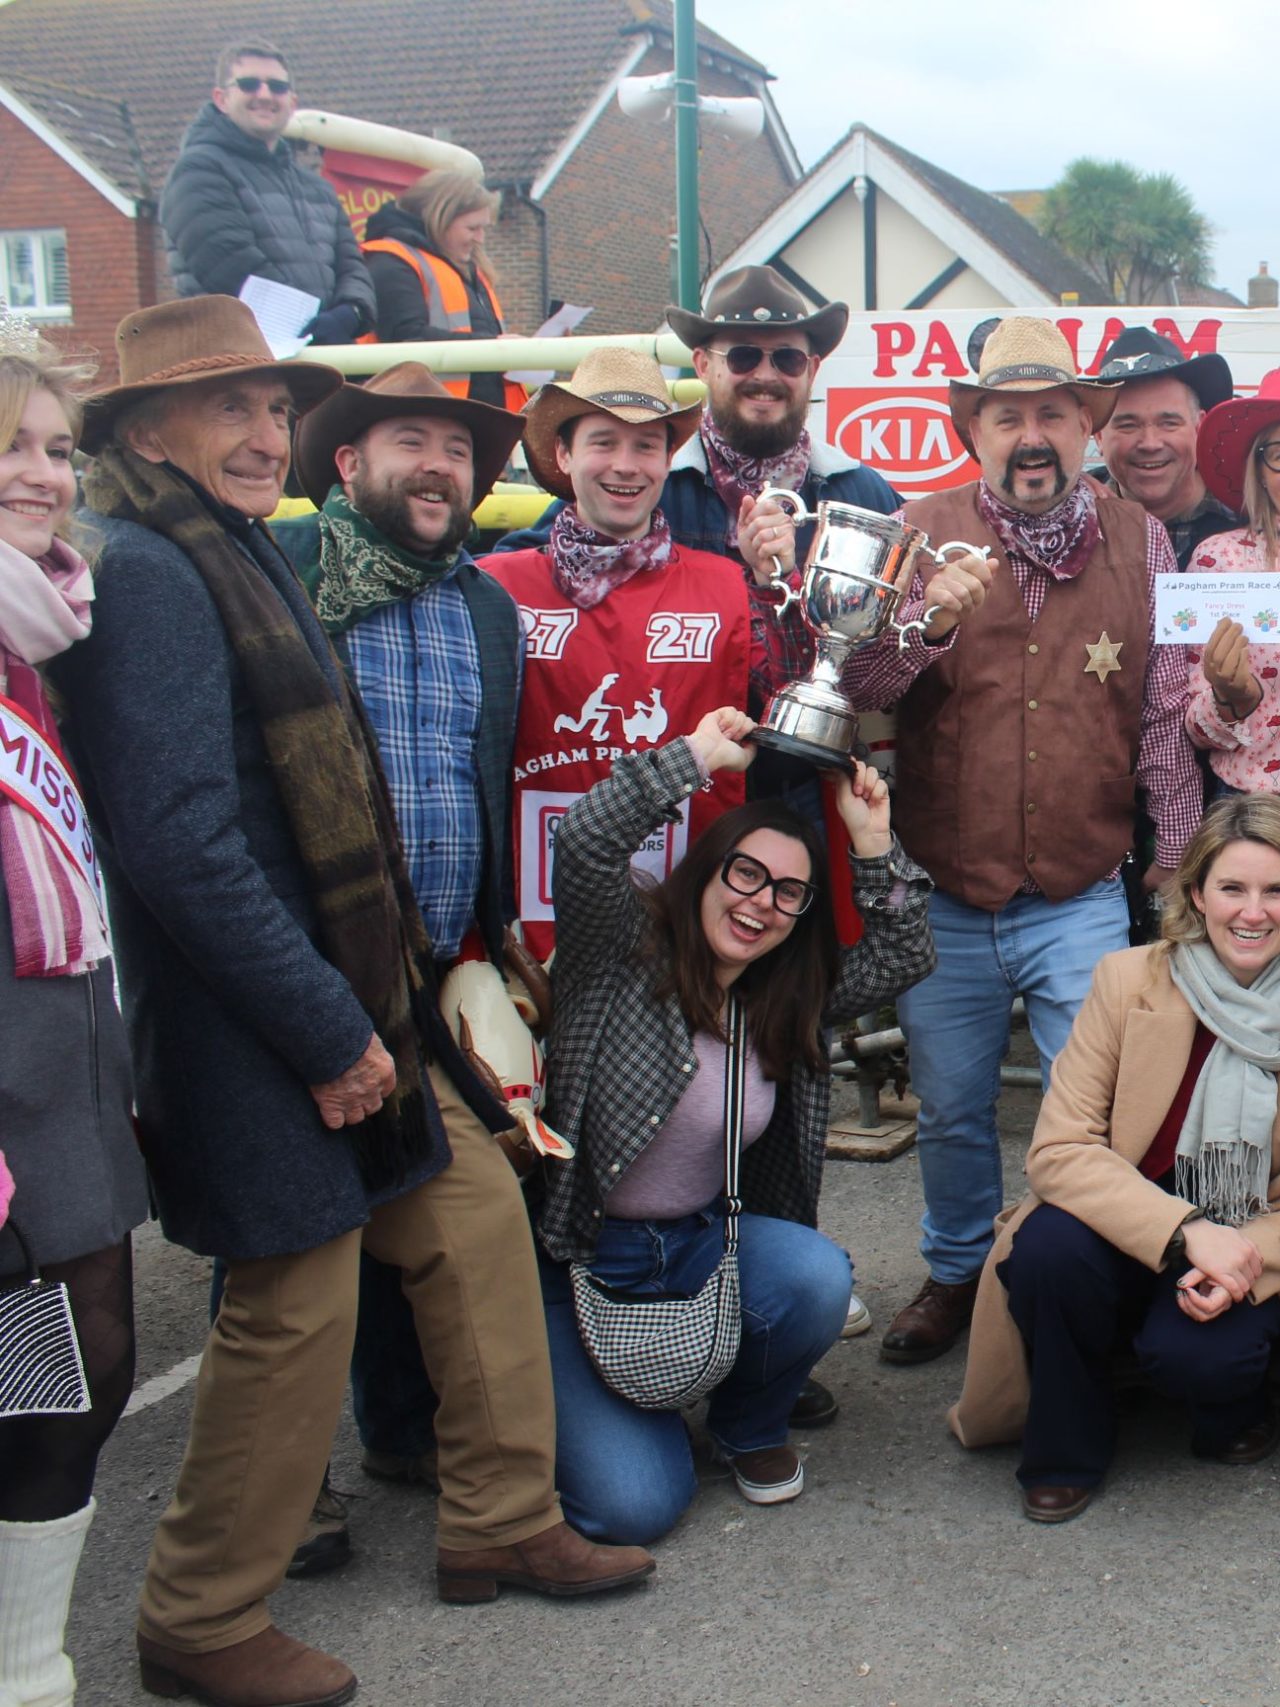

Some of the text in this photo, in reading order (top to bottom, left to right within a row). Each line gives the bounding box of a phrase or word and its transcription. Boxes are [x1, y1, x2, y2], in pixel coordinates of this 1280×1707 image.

[859, 418, 952, 461] KIA
[1178, 582, 1217, 591] Pagham
[1248, 581, 1271, 589] Race
[645, 611, 721, 663] 27
[0, 717, 77, 832] MISS
[513, 747, 589, 782] AGHAM
